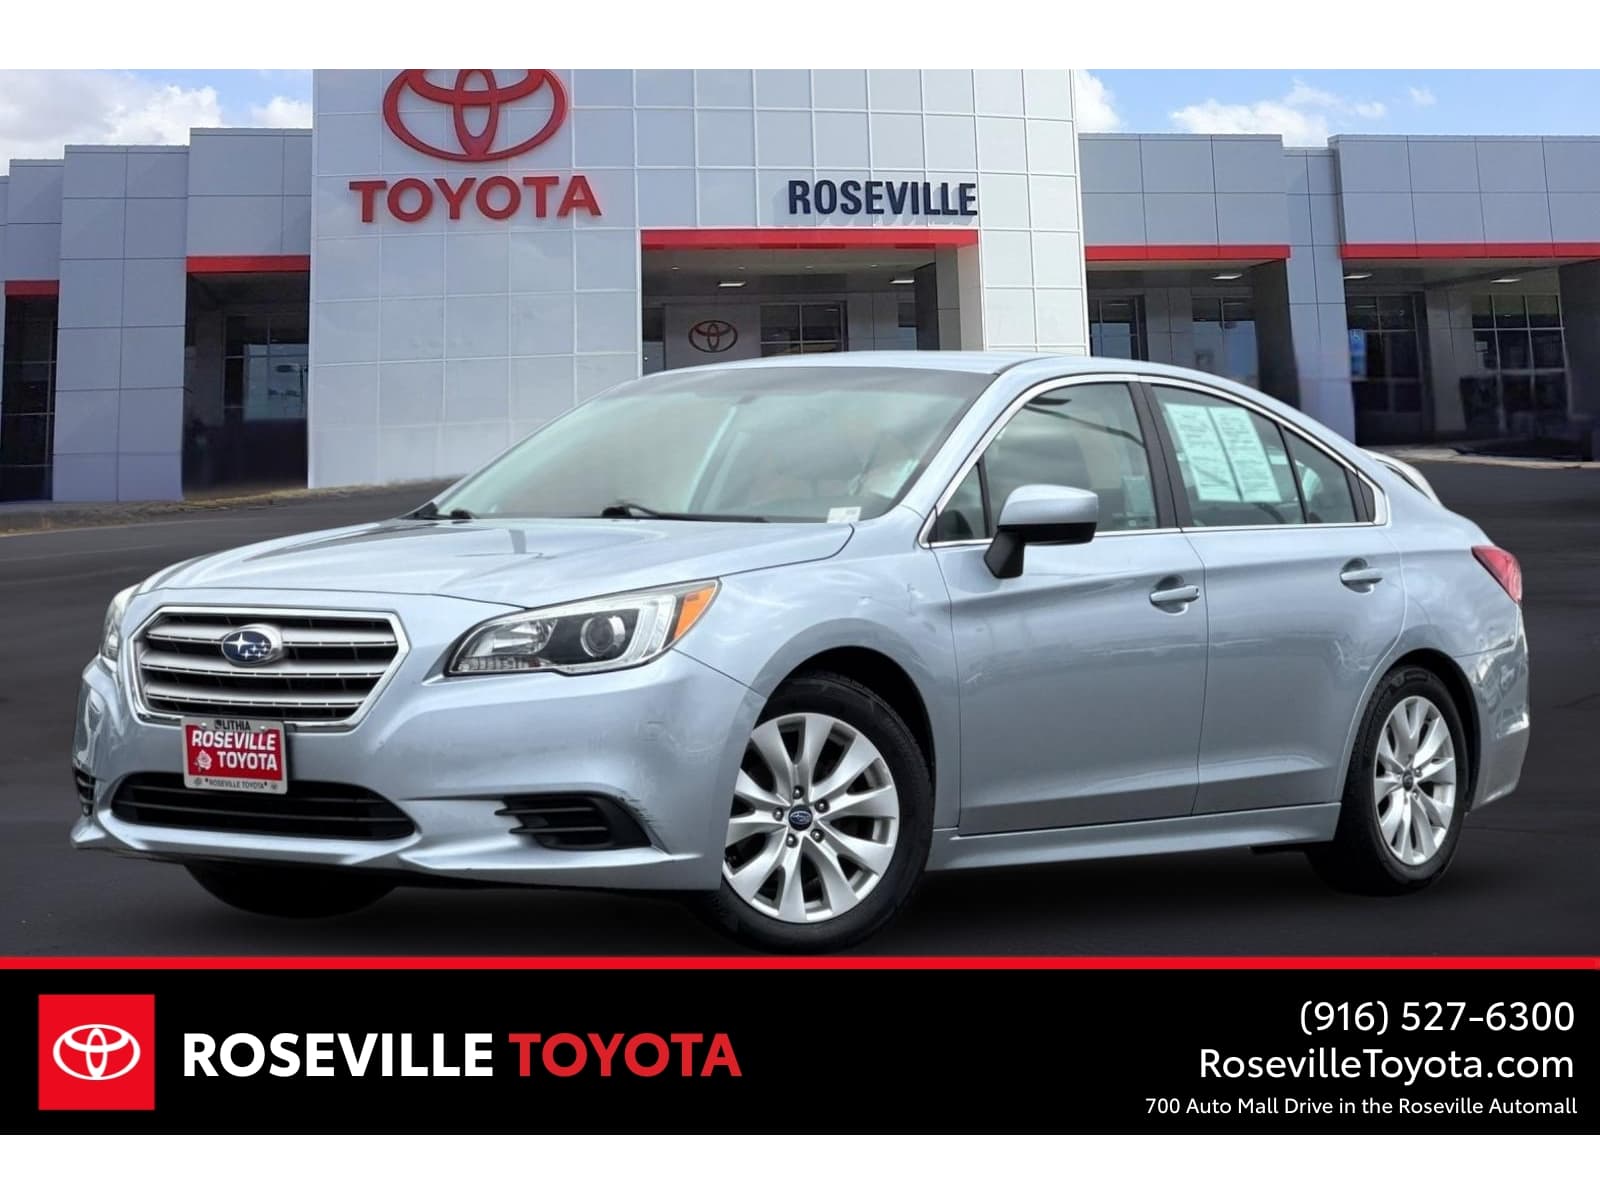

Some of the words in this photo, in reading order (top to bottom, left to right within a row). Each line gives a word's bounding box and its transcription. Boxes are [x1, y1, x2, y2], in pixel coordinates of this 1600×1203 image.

[349, 175, 602, 223] TOYOTA
[788, 180, 978, 216] ROSEVILLE
[191, 729, 277, 751] ROSEVILLE
[216, 751, 278, 771] TOYOTA
